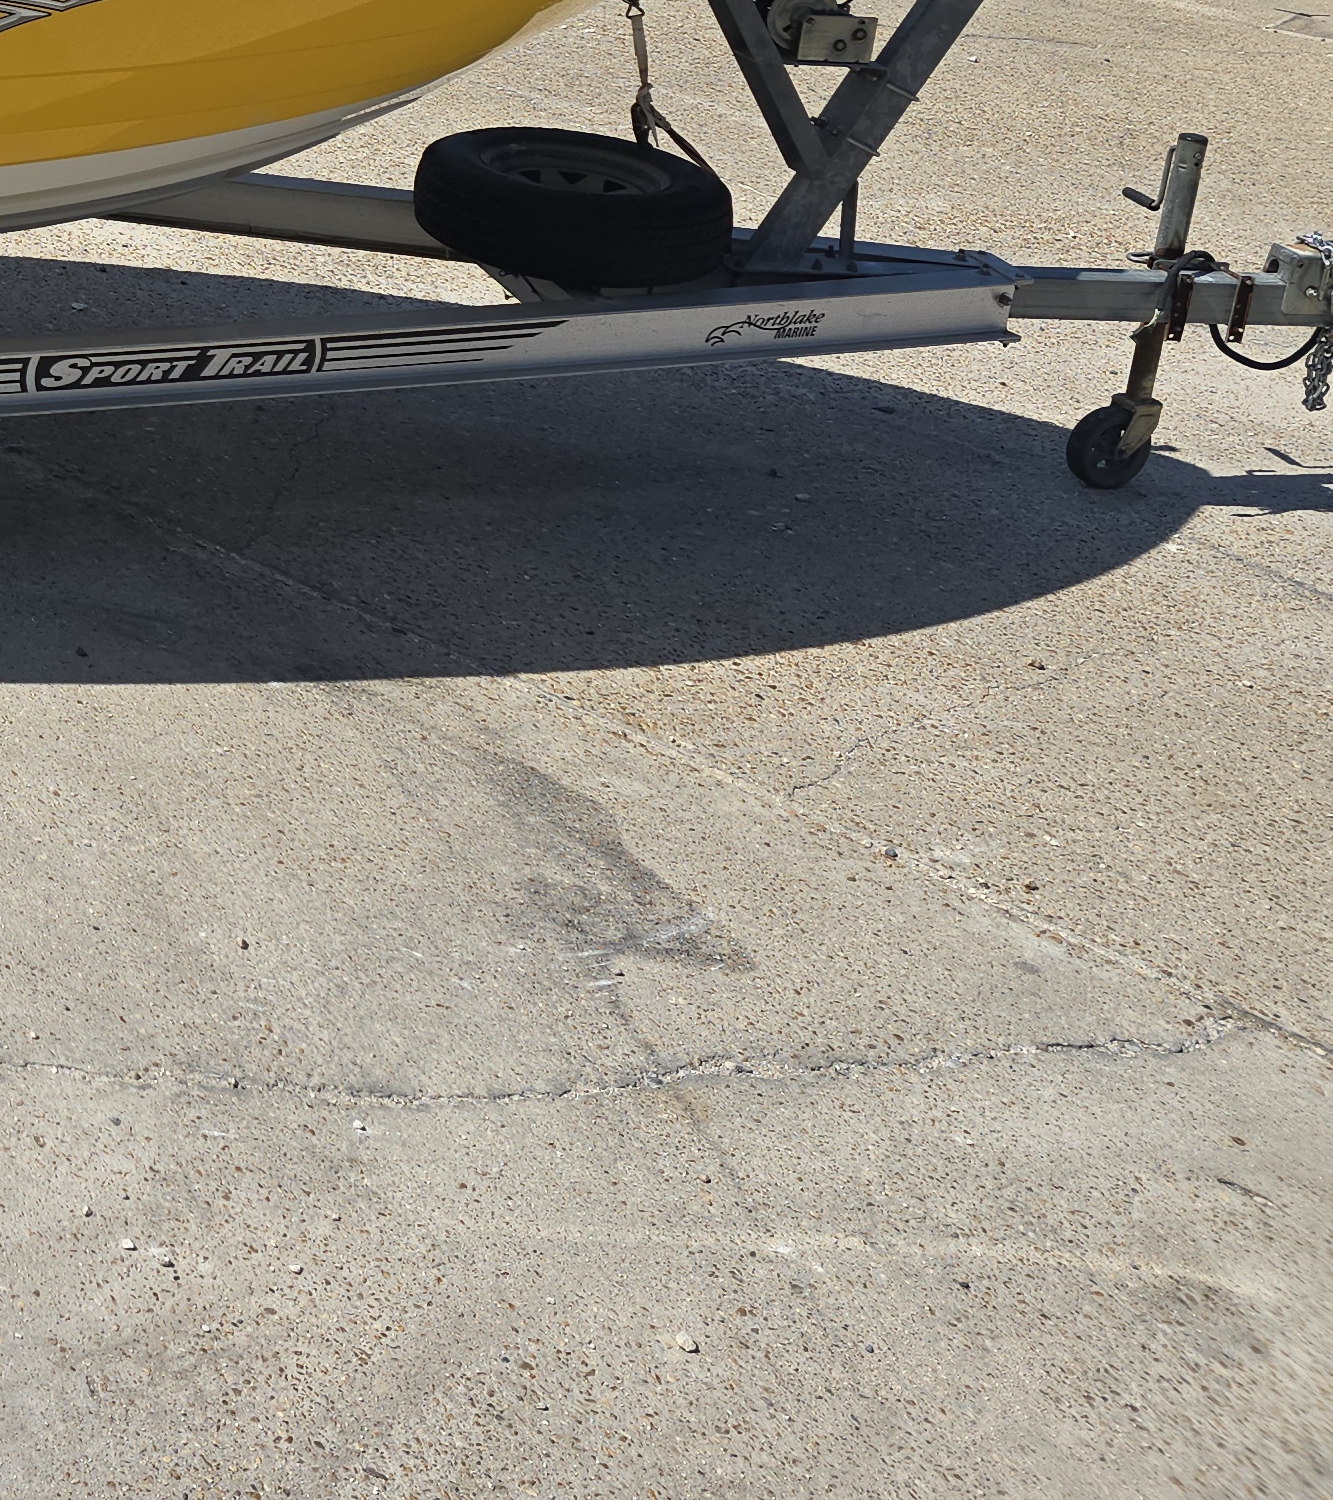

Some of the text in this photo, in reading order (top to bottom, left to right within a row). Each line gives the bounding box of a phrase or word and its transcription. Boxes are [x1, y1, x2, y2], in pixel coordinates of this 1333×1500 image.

[739, 309, 826, 329] Northlake
[773, 326, 818, 339] MARINE
[40, 343, 308, 388] SPORT TRAIL
